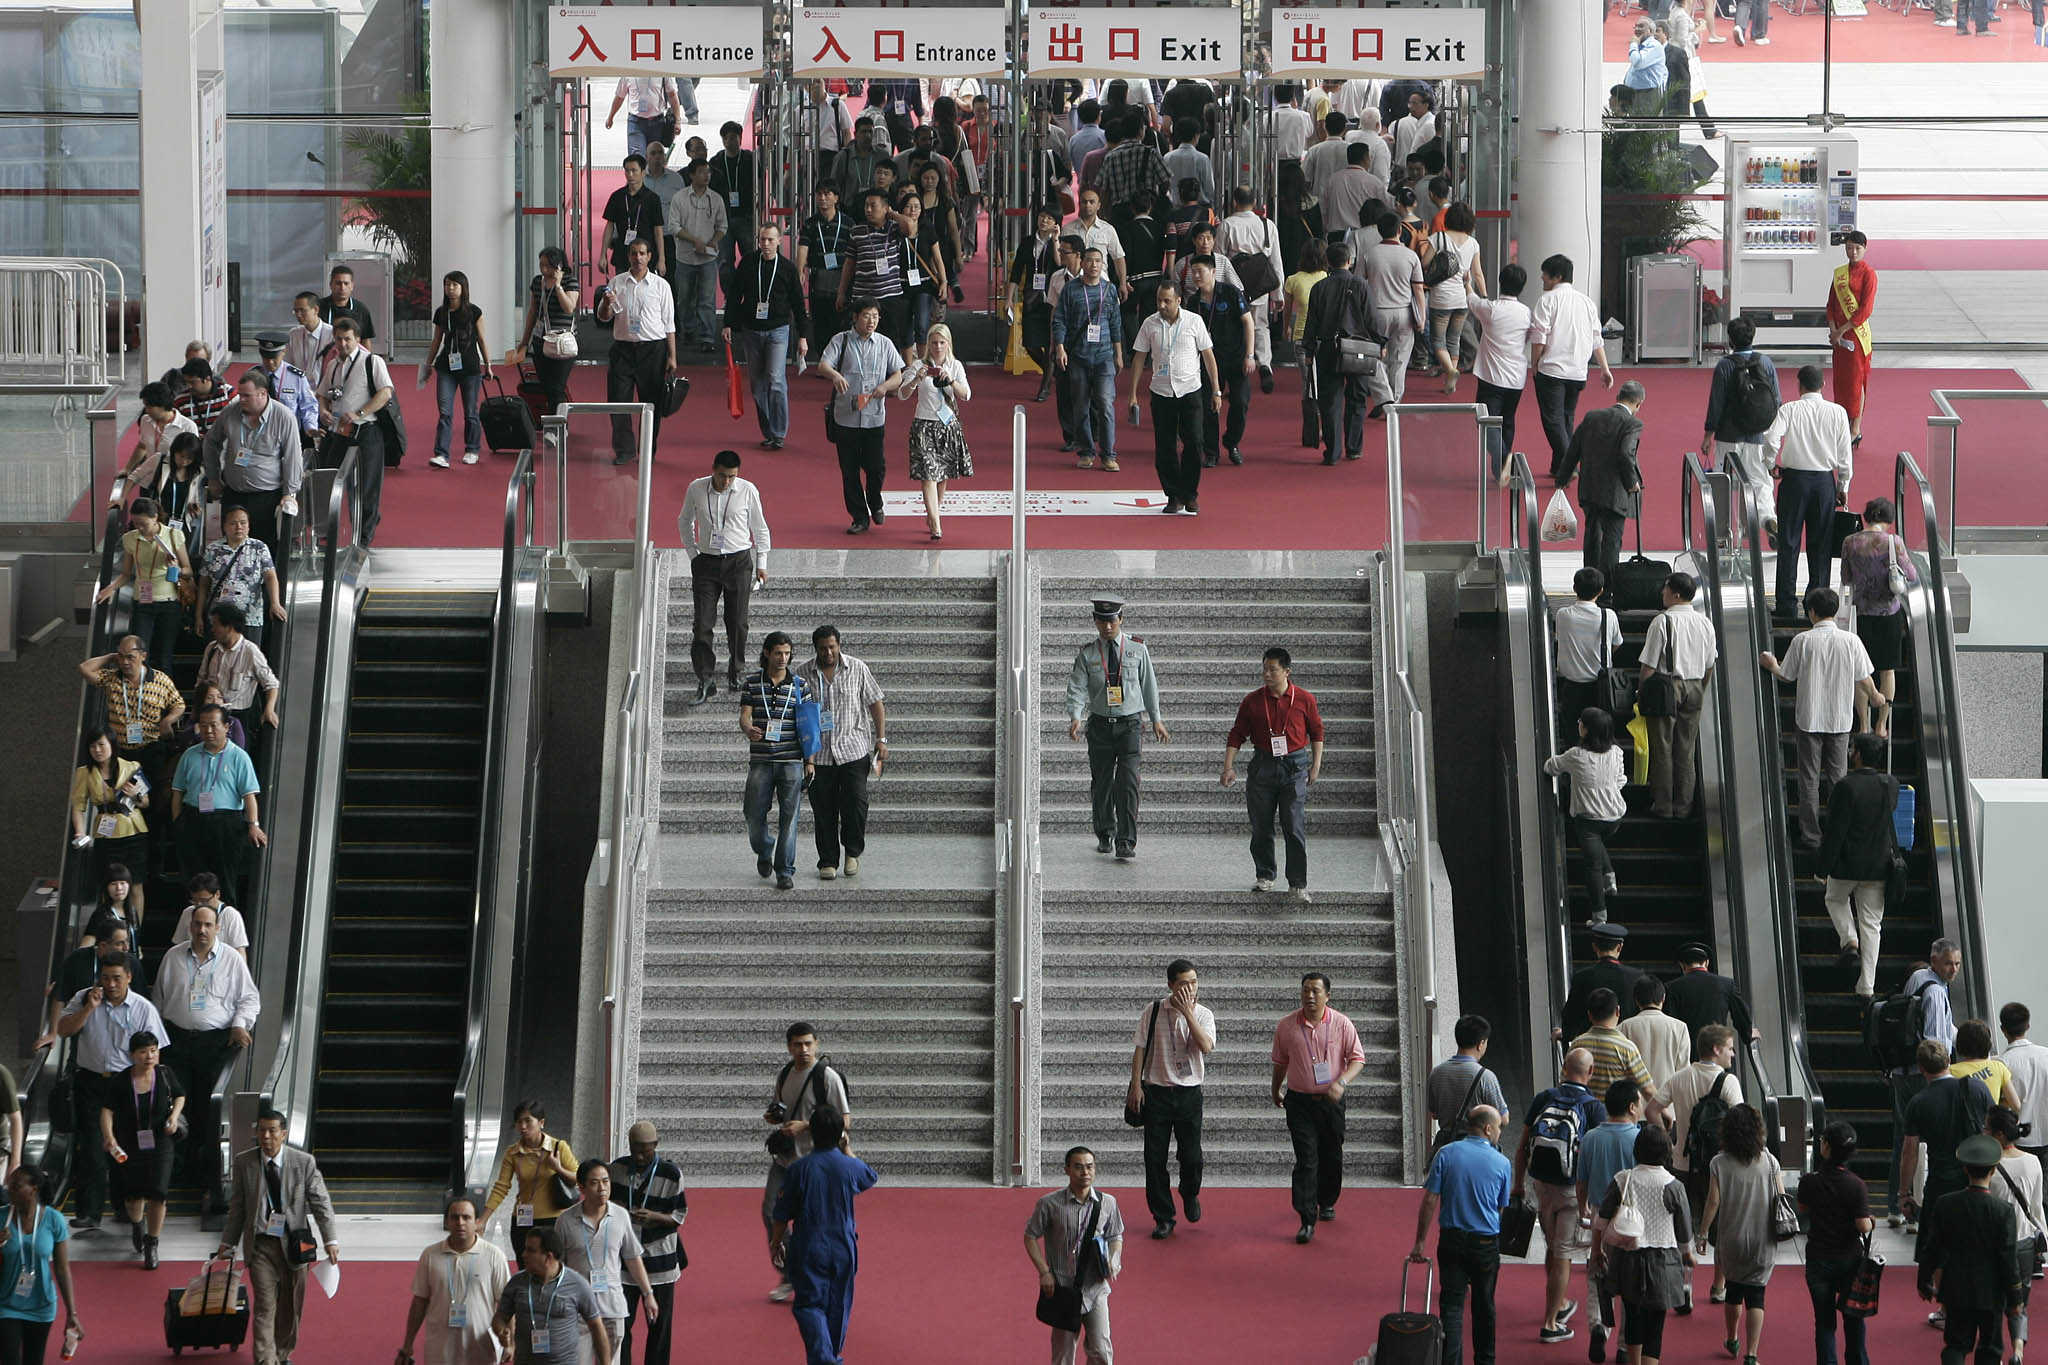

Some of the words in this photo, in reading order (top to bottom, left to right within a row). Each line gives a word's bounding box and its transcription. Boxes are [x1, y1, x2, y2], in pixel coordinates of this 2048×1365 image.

[568, 24, 661, 62] 入口
[672, 42, 754, 61] Entrance
[812, 25, 905, 63] 入口
[916, 43, 996, 61] Entrance
[1048, 23, 1139, 63] 出口
[1161, 38, 1221, 61] Exit
[1291, 23, 1384, 63] 出口
[1405, 38, 1466, 62] Exit
